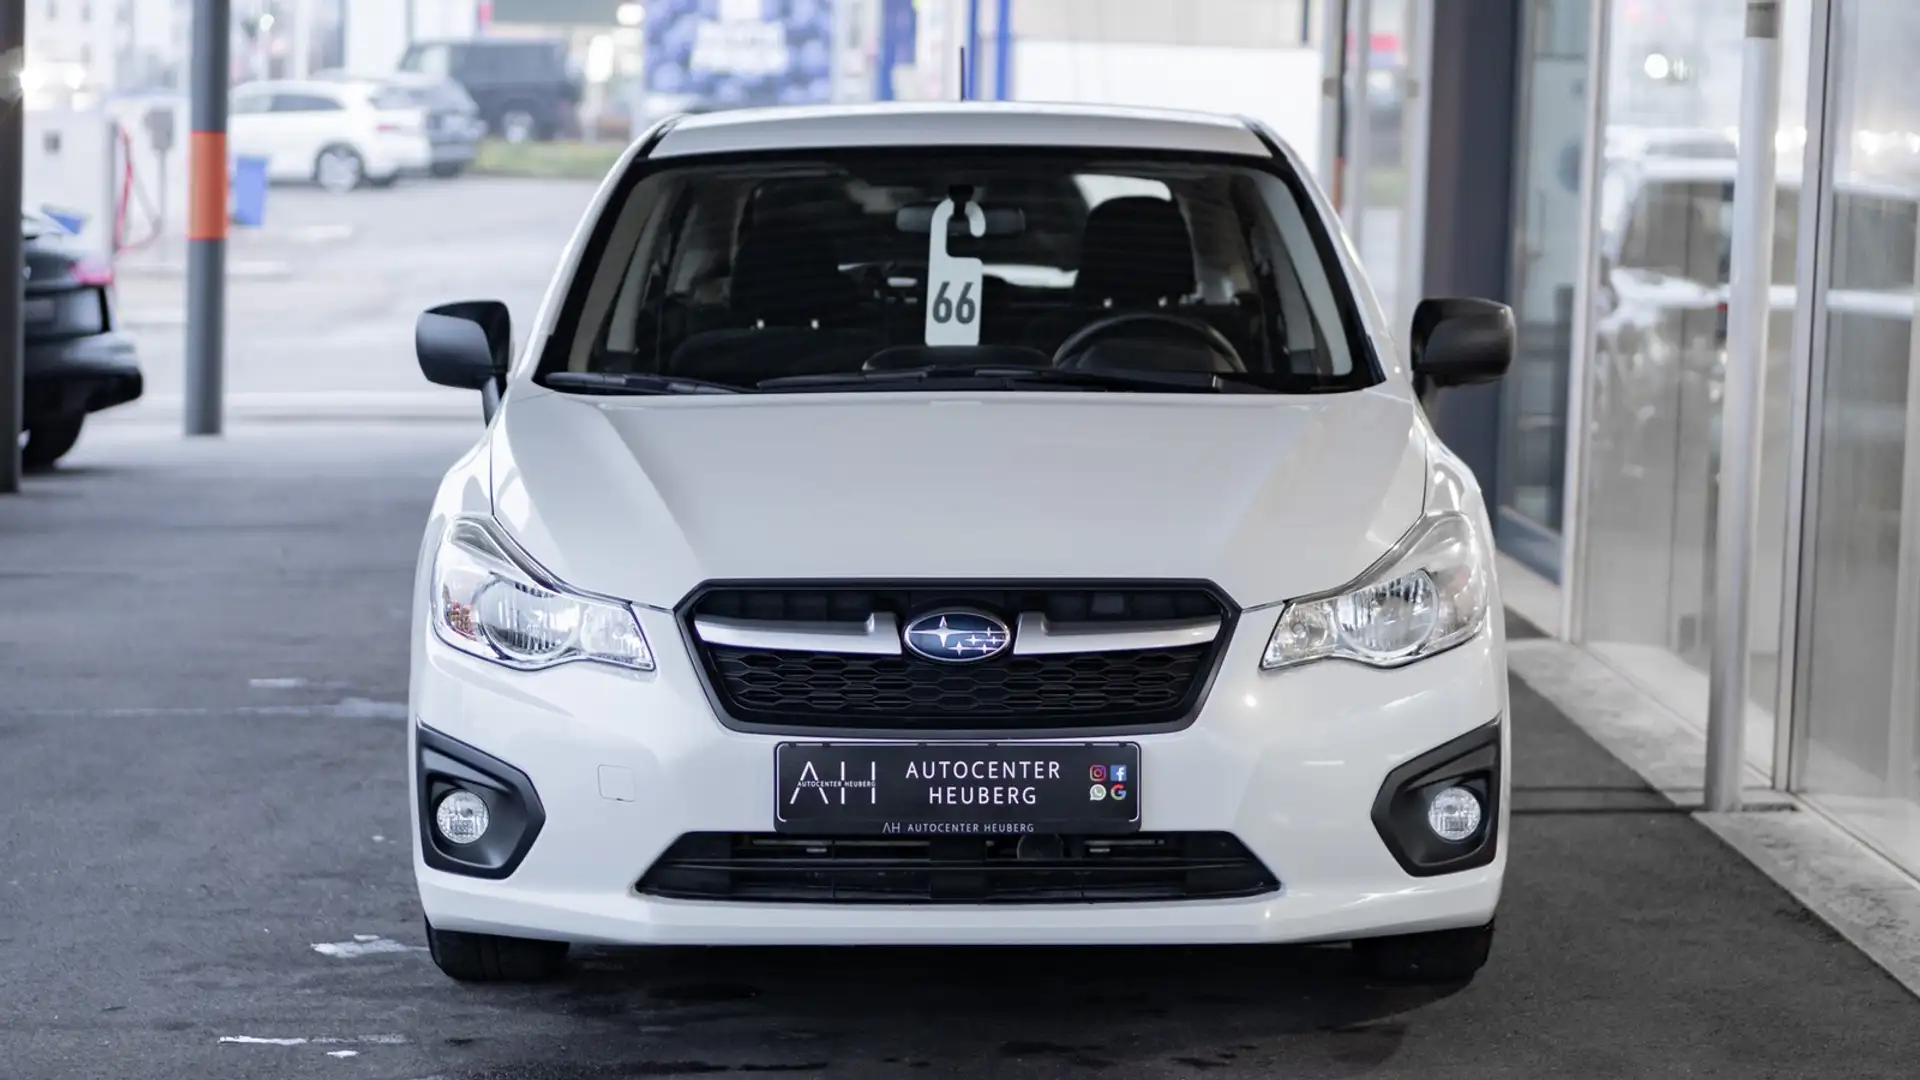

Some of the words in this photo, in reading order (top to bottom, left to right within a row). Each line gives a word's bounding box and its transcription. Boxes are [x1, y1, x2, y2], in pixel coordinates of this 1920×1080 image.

[932, 281, 976, 325] 66
[905, 761, 1061, 779] AUTOCENTER
[789, 760, 876, 805] AH
[797, 780, 842, 788] AUTOCENTER
[844, 780, 876, 788] HEUBERG
[929, 786, 1036, 804] HEUBERG
[882, 822, 900, 833] AH
[907, 823, 979, 833] AUTOCENTER
[983, 823, 1035, 833] HEUBERG
